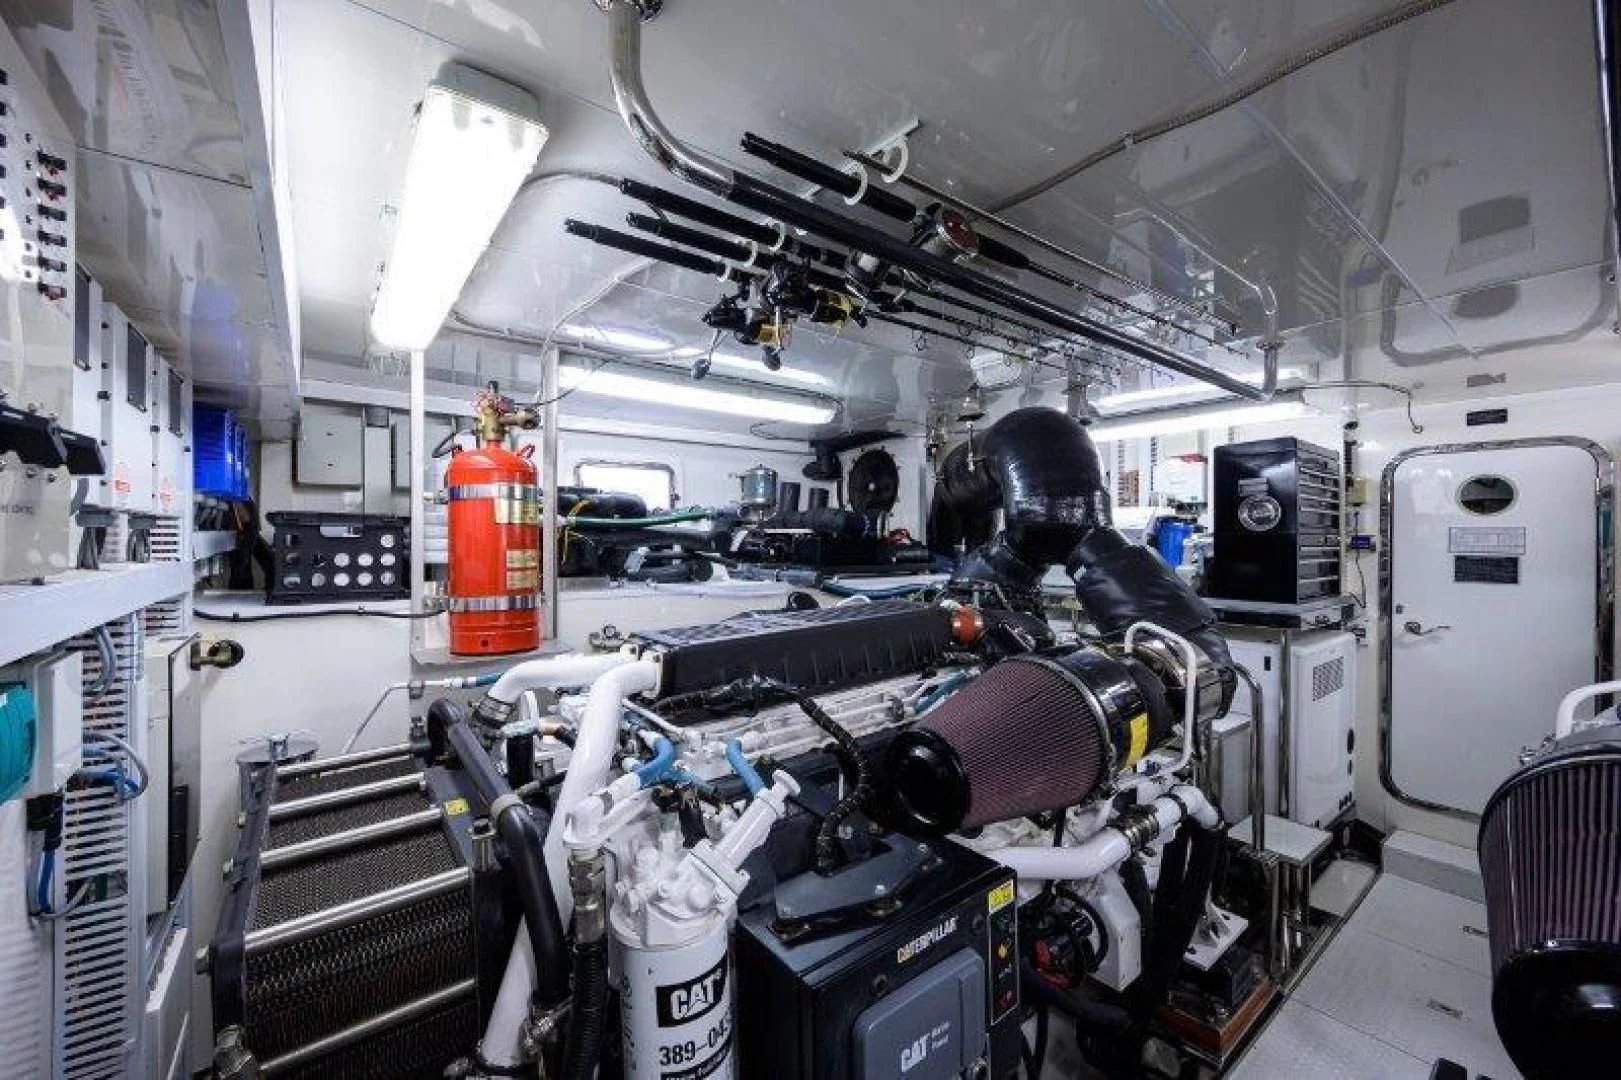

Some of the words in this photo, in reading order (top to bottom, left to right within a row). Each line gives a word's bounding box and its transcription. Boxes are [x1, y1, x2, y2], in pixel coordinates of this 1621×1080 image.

[897, 917, 957, 963] CATERPILLAR
[670, 977, 715, 1021] CAT
[901, 1032, 931, 1073] CAT
